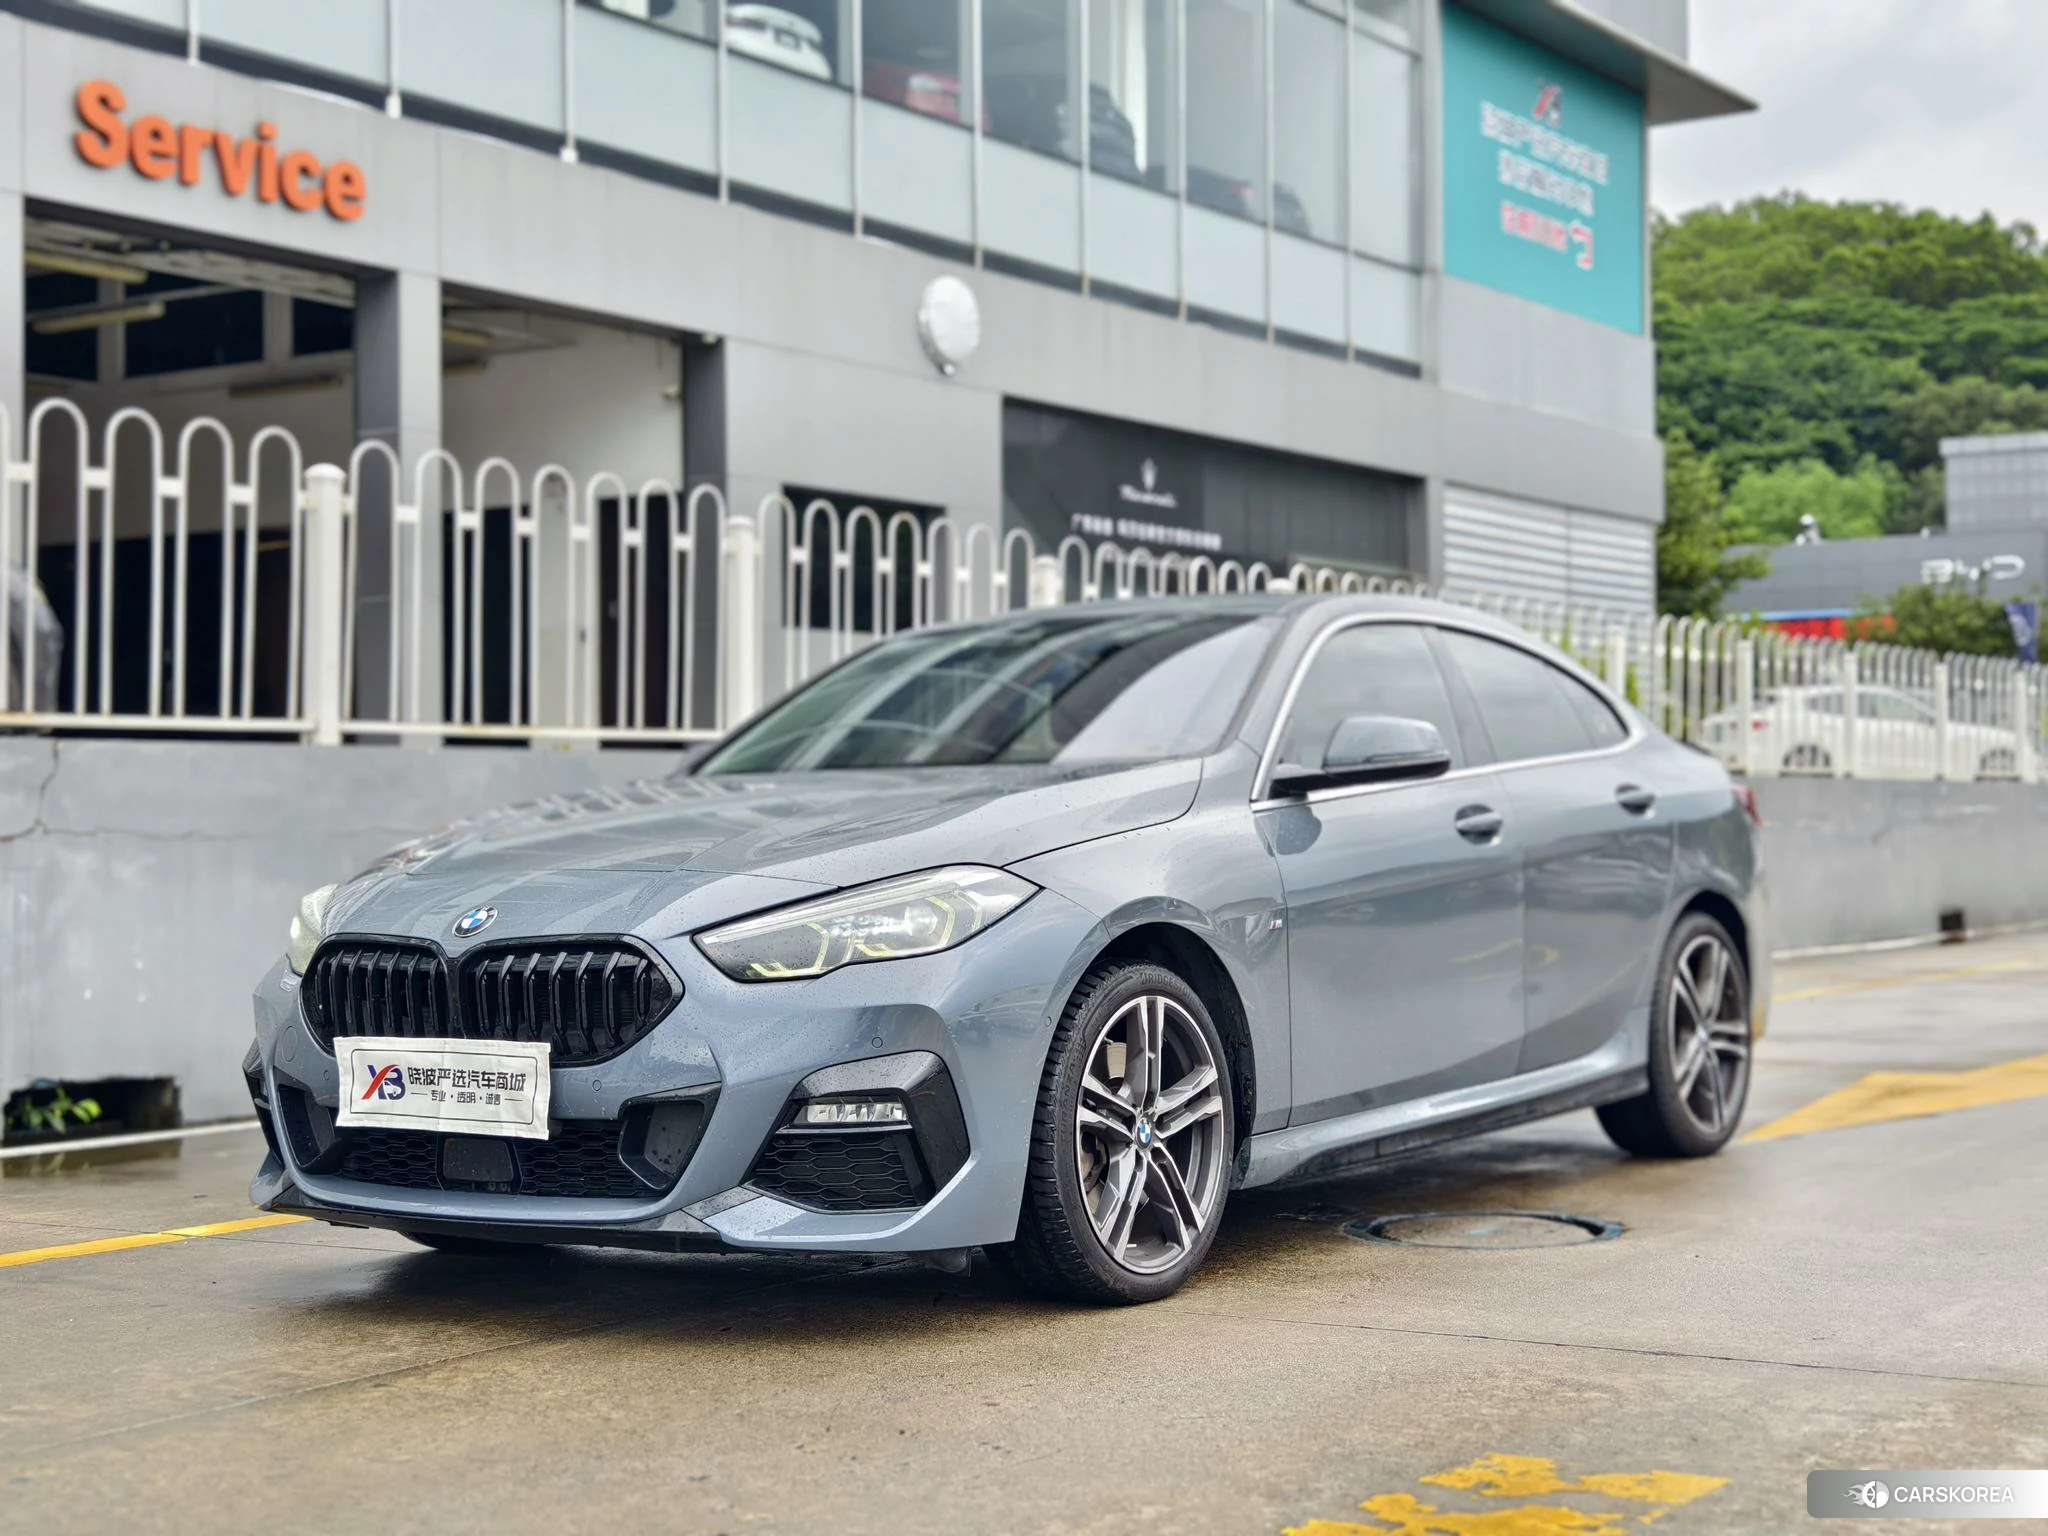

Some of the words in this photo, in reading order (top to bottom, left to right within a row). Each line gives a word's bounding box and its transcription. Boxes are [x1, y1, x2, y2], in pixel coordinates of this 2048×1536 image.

[74, 79, 366, 222] Service
[407, 1066, 526, 1092] 晓波严选汽车商城
